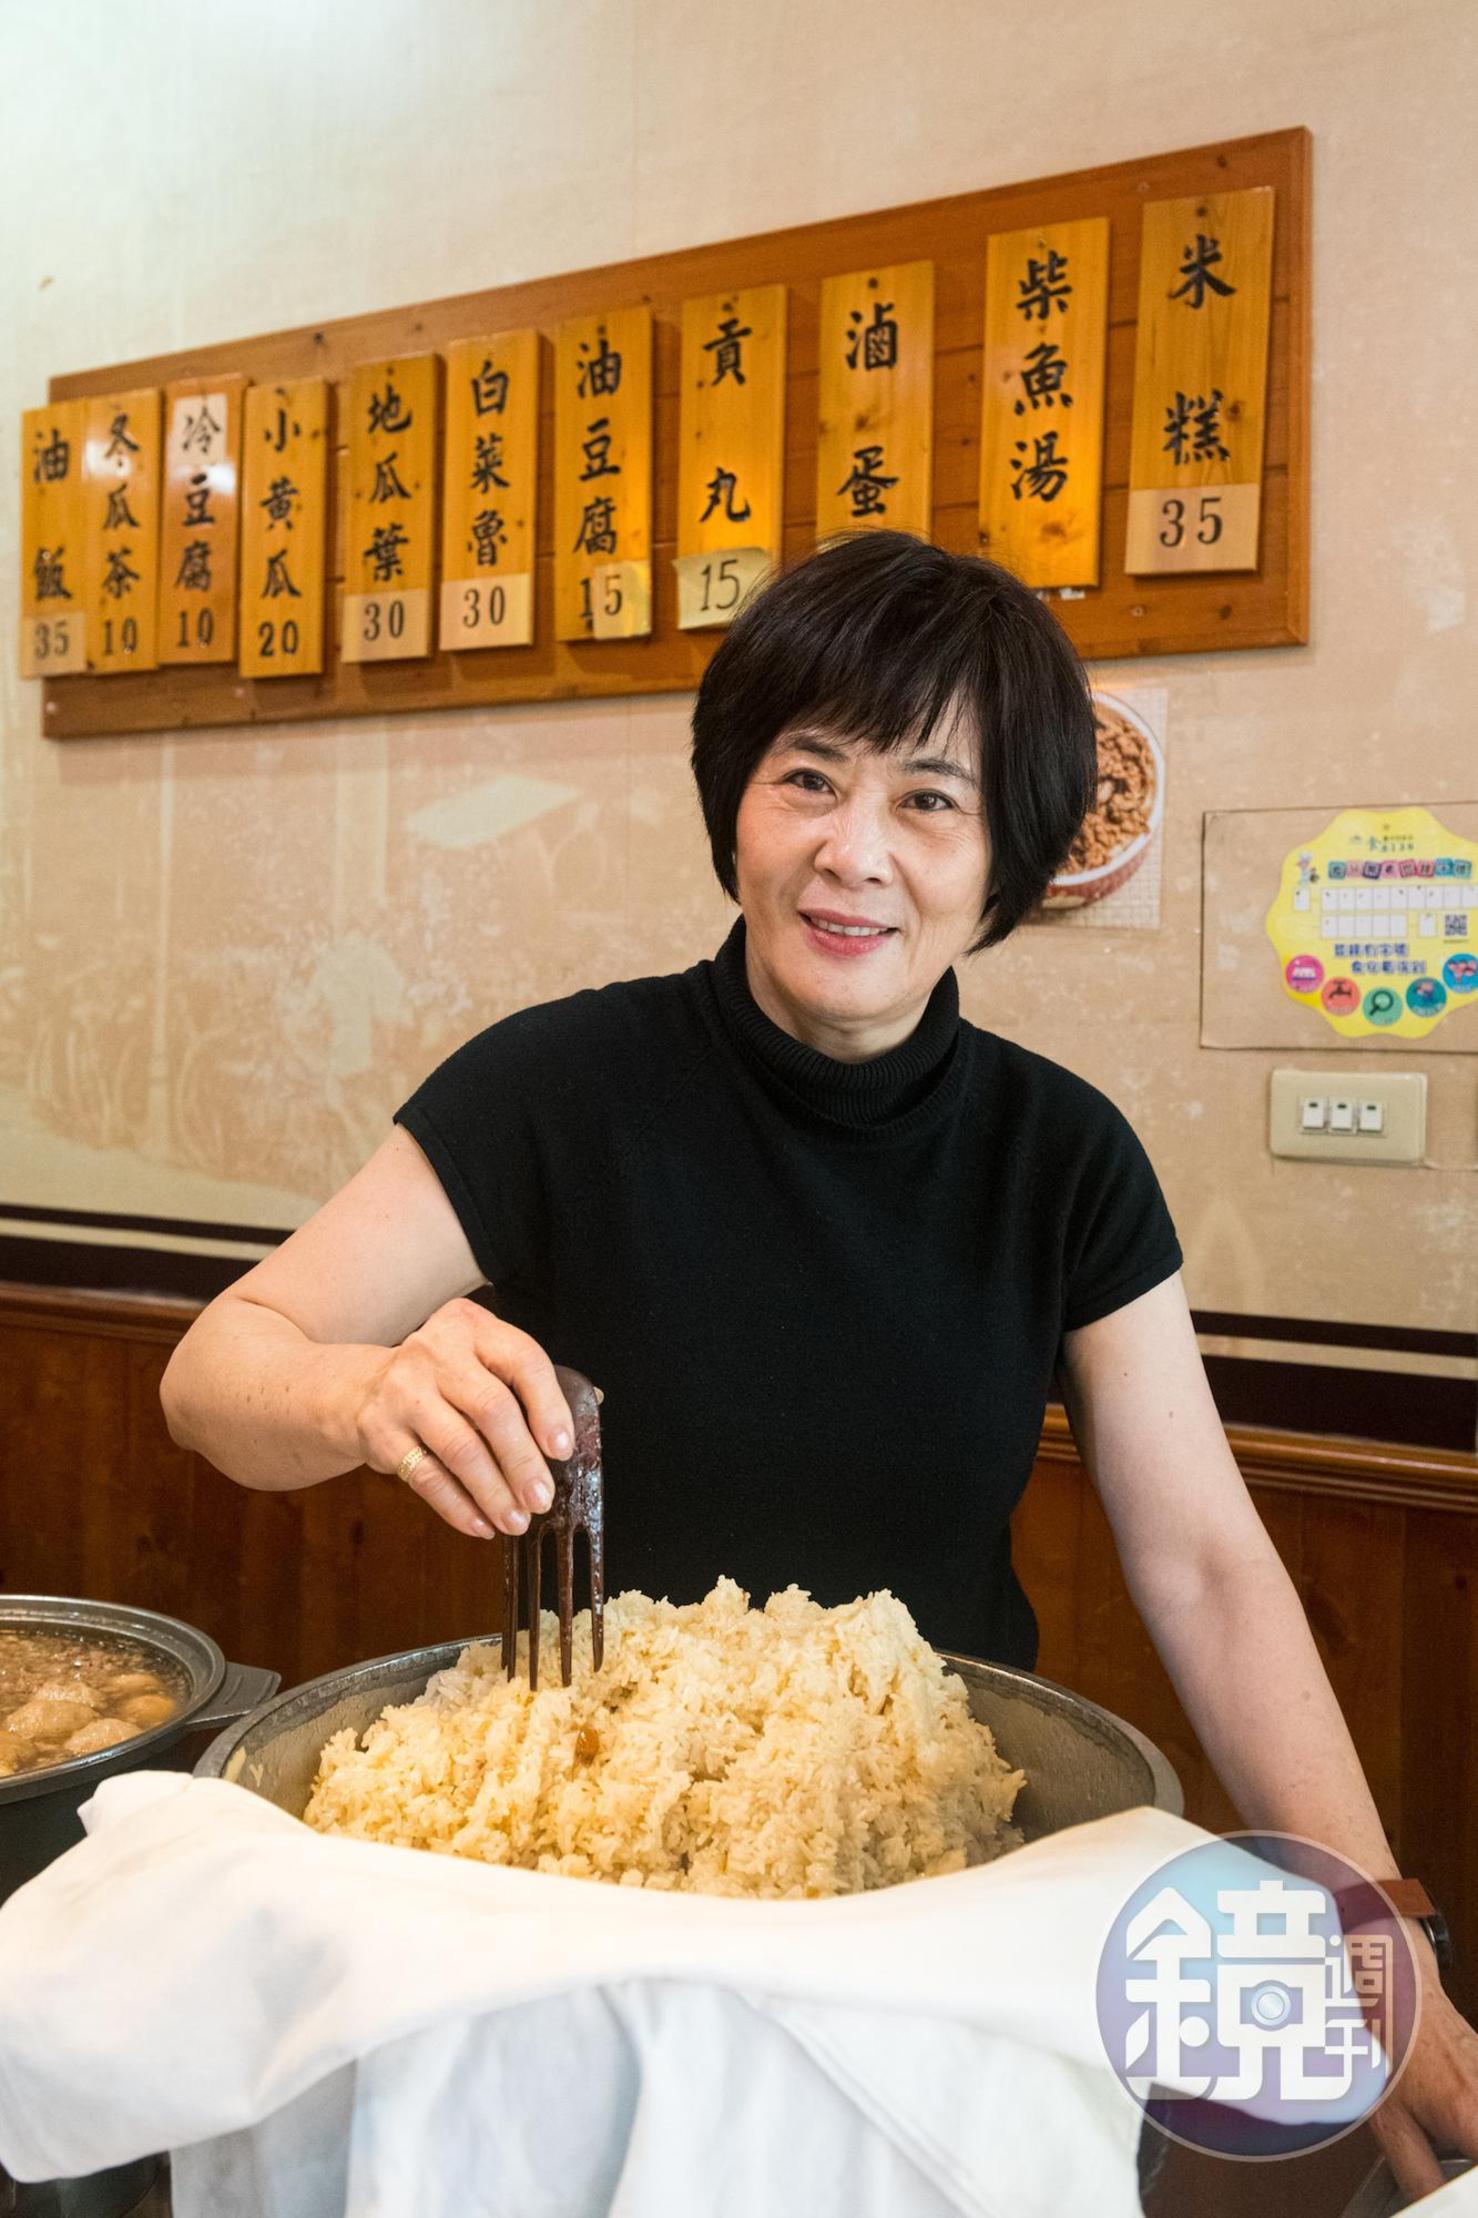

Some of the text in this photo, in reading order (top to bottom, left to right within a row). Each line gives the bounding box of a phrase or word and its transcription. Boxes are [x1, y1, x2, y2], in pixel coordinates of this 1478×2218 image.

[699, 317, 752, 523] 貢丸
[838, 302, 899, 518] 滷蛋
[1010, 250, 1072, 502] 柴魚湯
[1163, 233, 1236, 465] 米糕
[34, 429, 72, 600] 油飯
[103, 413, 140, 598] 冬瓜茶
[174, 406, 221, 590] 冷豆腐
[260, 408, 302, 598] 小黃瓜
[363, 384, 412, 582] 地瓜葉
[467, 360, 511, 566] 白菜魯
[574, 338, 622, 555] 油豆腐
[1160, 496, 1223, 547] 35
[34, 620, 70, 660] 35
[103, 618, 138, 656] 10
[178, 608, 214, 648] 10
[258, 620, 299, 657] 20
[364, 600, 405, 641] 30
[463, 586, 506, 628] 30
[580, 574, 623, 618] 15
[701, 558, 742, 612] 15
